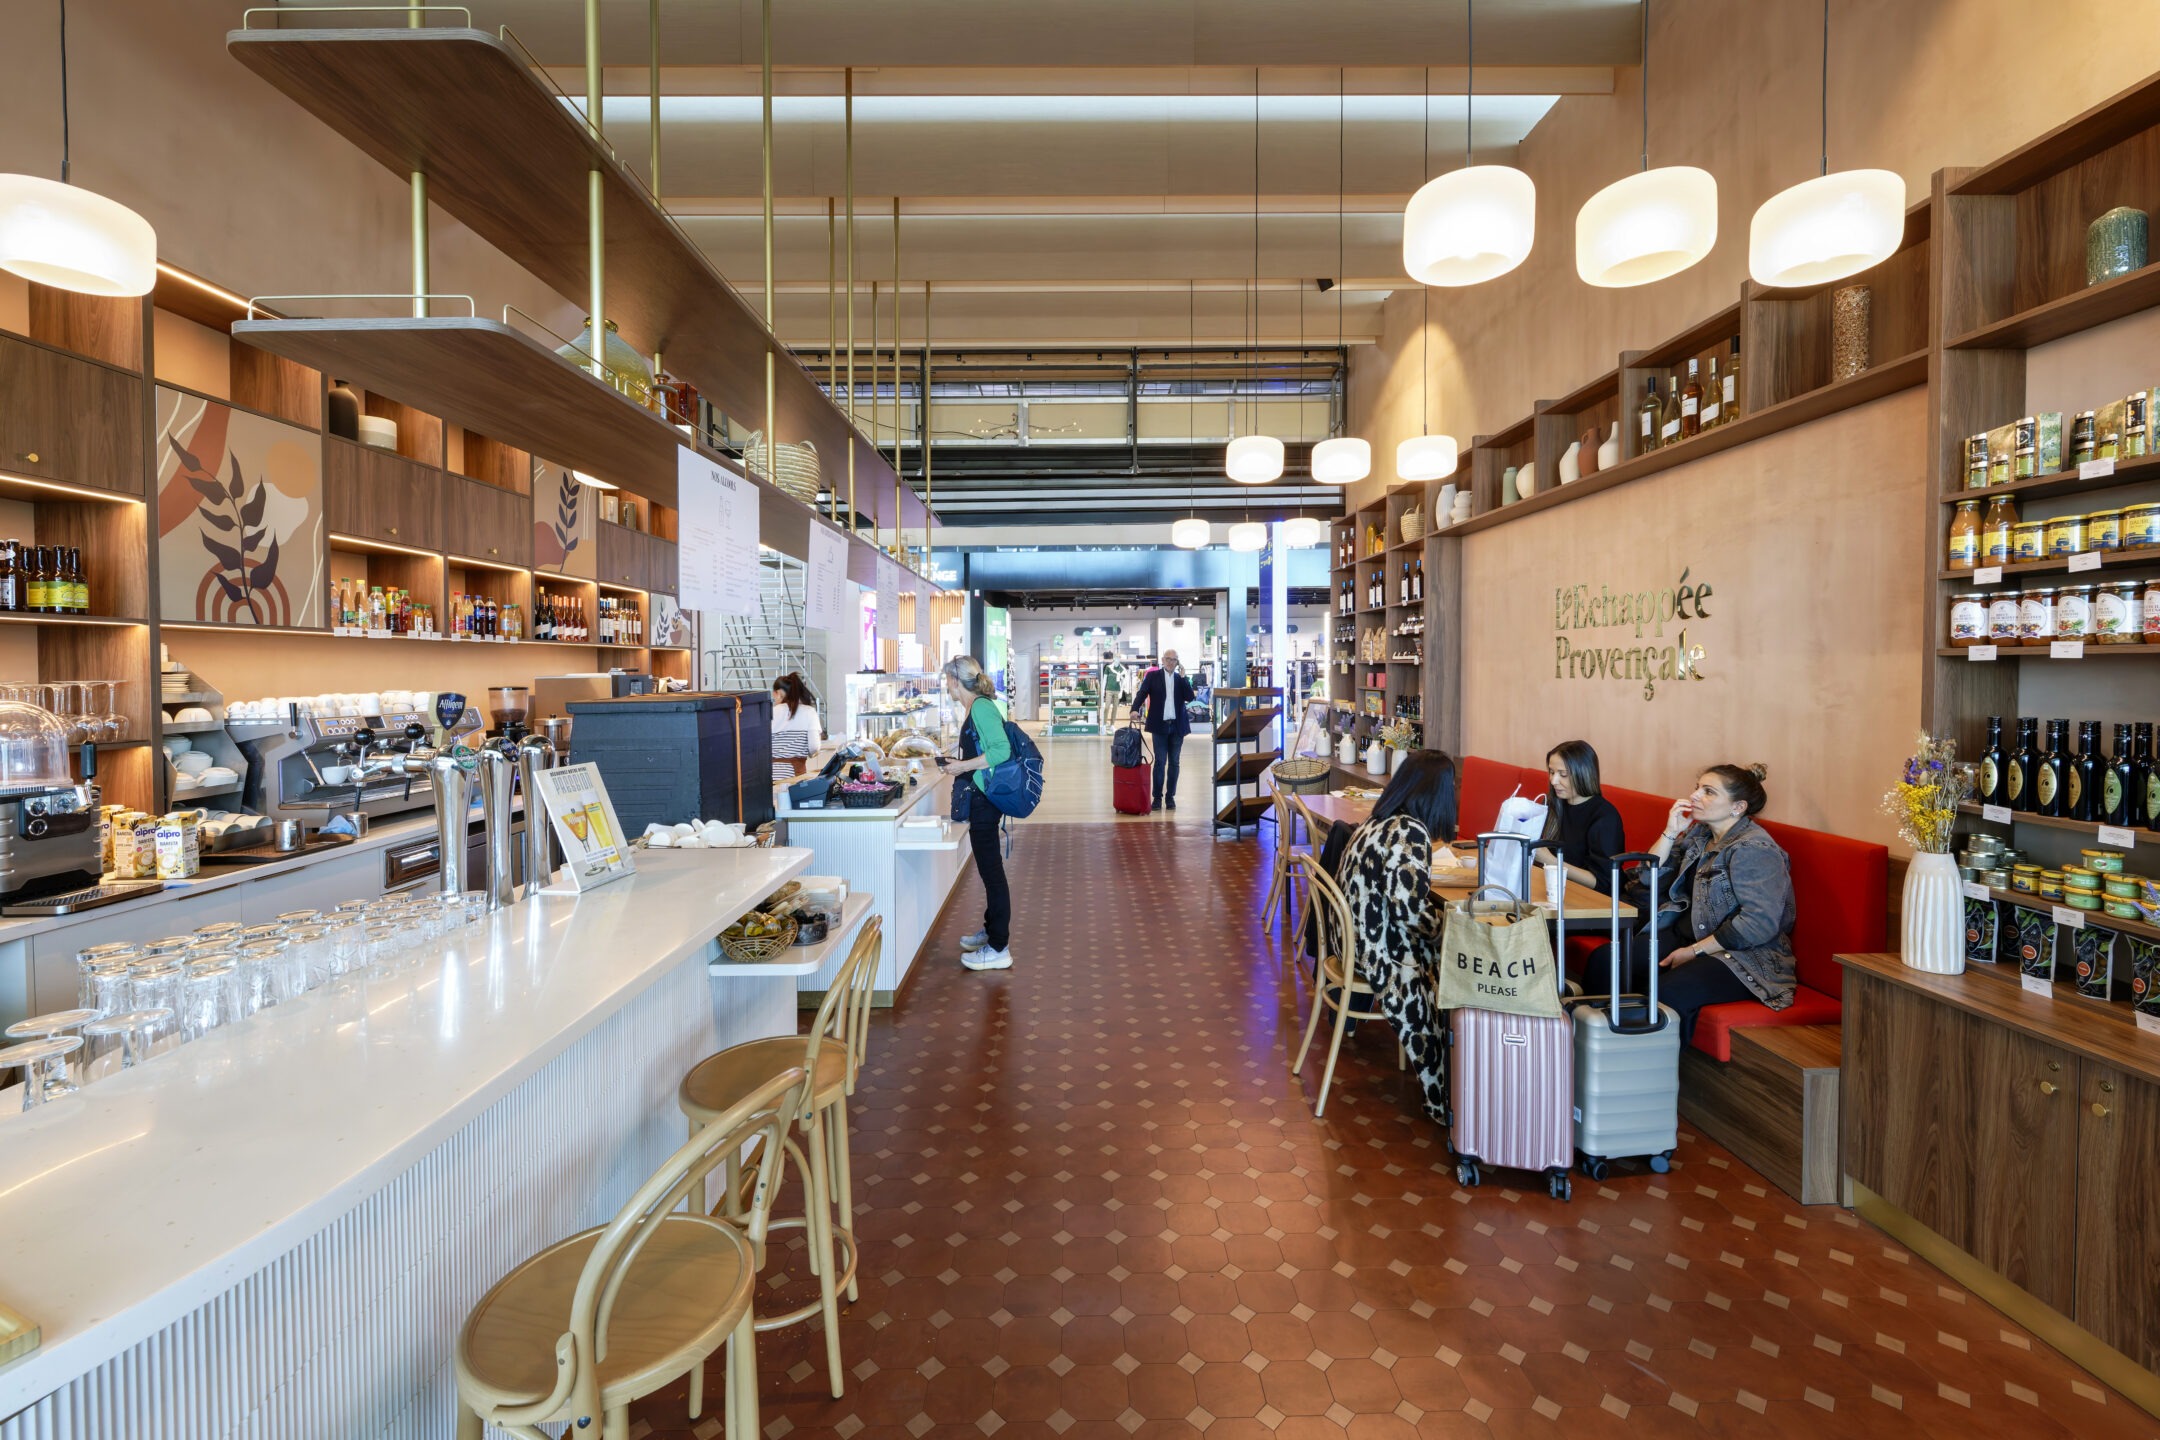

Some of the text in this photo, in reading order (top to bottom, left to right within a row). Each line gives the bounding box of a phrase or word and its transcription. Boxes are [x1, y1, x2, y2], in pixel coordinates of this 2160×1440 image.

[711, 470, 736, 491] NOS ALCOOLS
[1555, 628, 1707, 702] Provençale
[135, 828, 156, 837] alpro
[157, 830, 181, 839] alpro
[1457, 952, 1536, 978] BEACH
[1477, 983, 1518, 997] PLEASE
